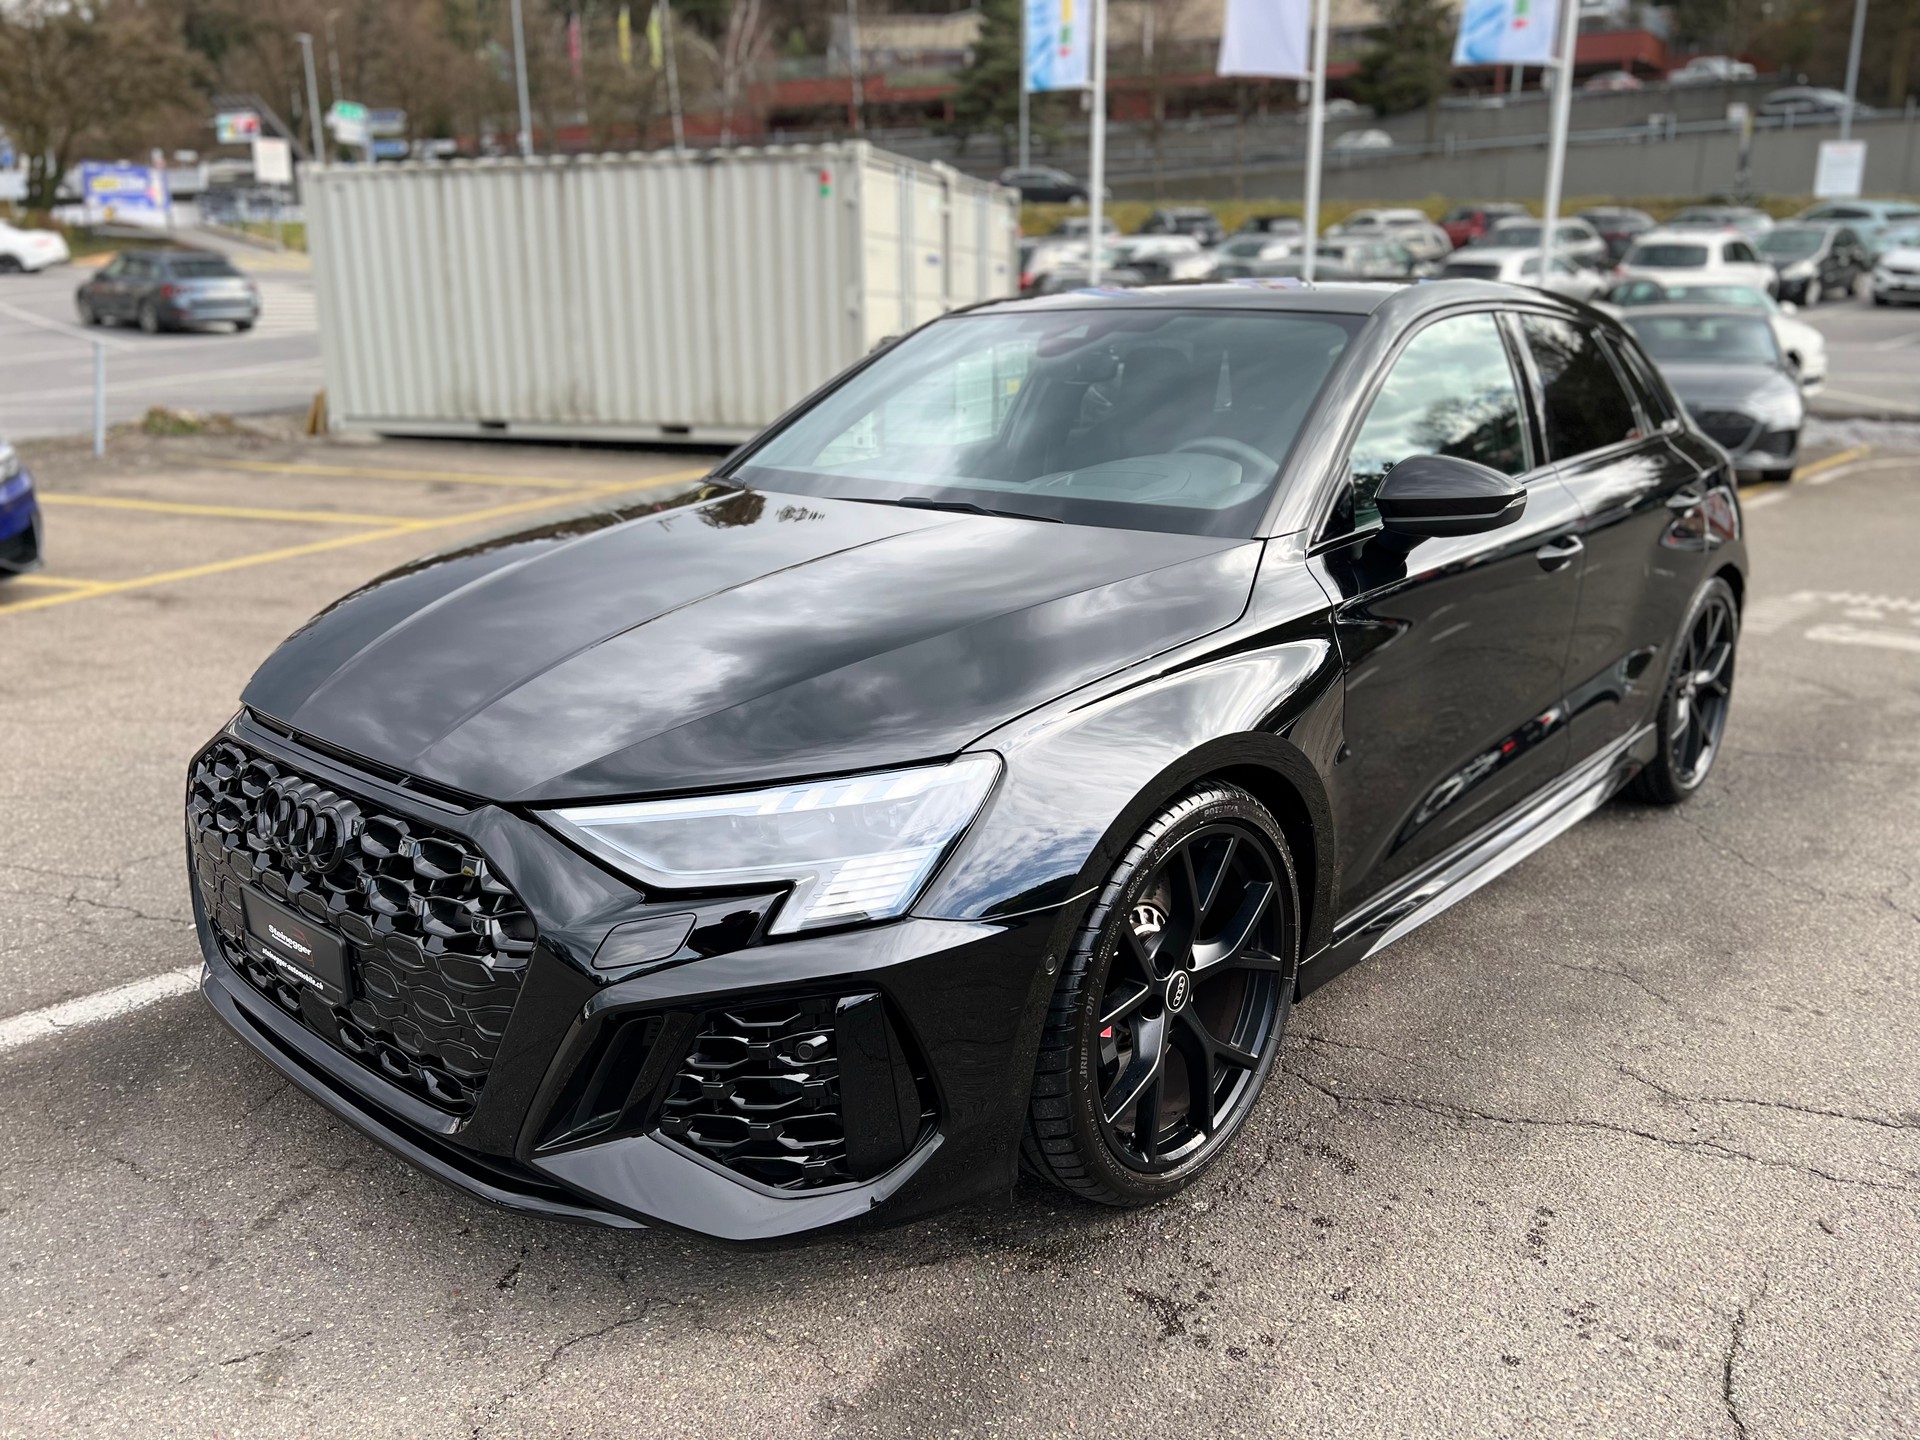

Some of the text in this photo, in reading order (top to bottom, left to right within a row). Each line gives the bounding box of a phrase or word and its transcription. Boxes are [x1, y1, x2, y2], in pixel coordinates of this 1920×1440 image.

[268, 924, 312, 956] Steinegger
[262, 948, 324, 990] steinegger-automobile.ch
[1080, 988, 1096, 1080] BRIDGSON
